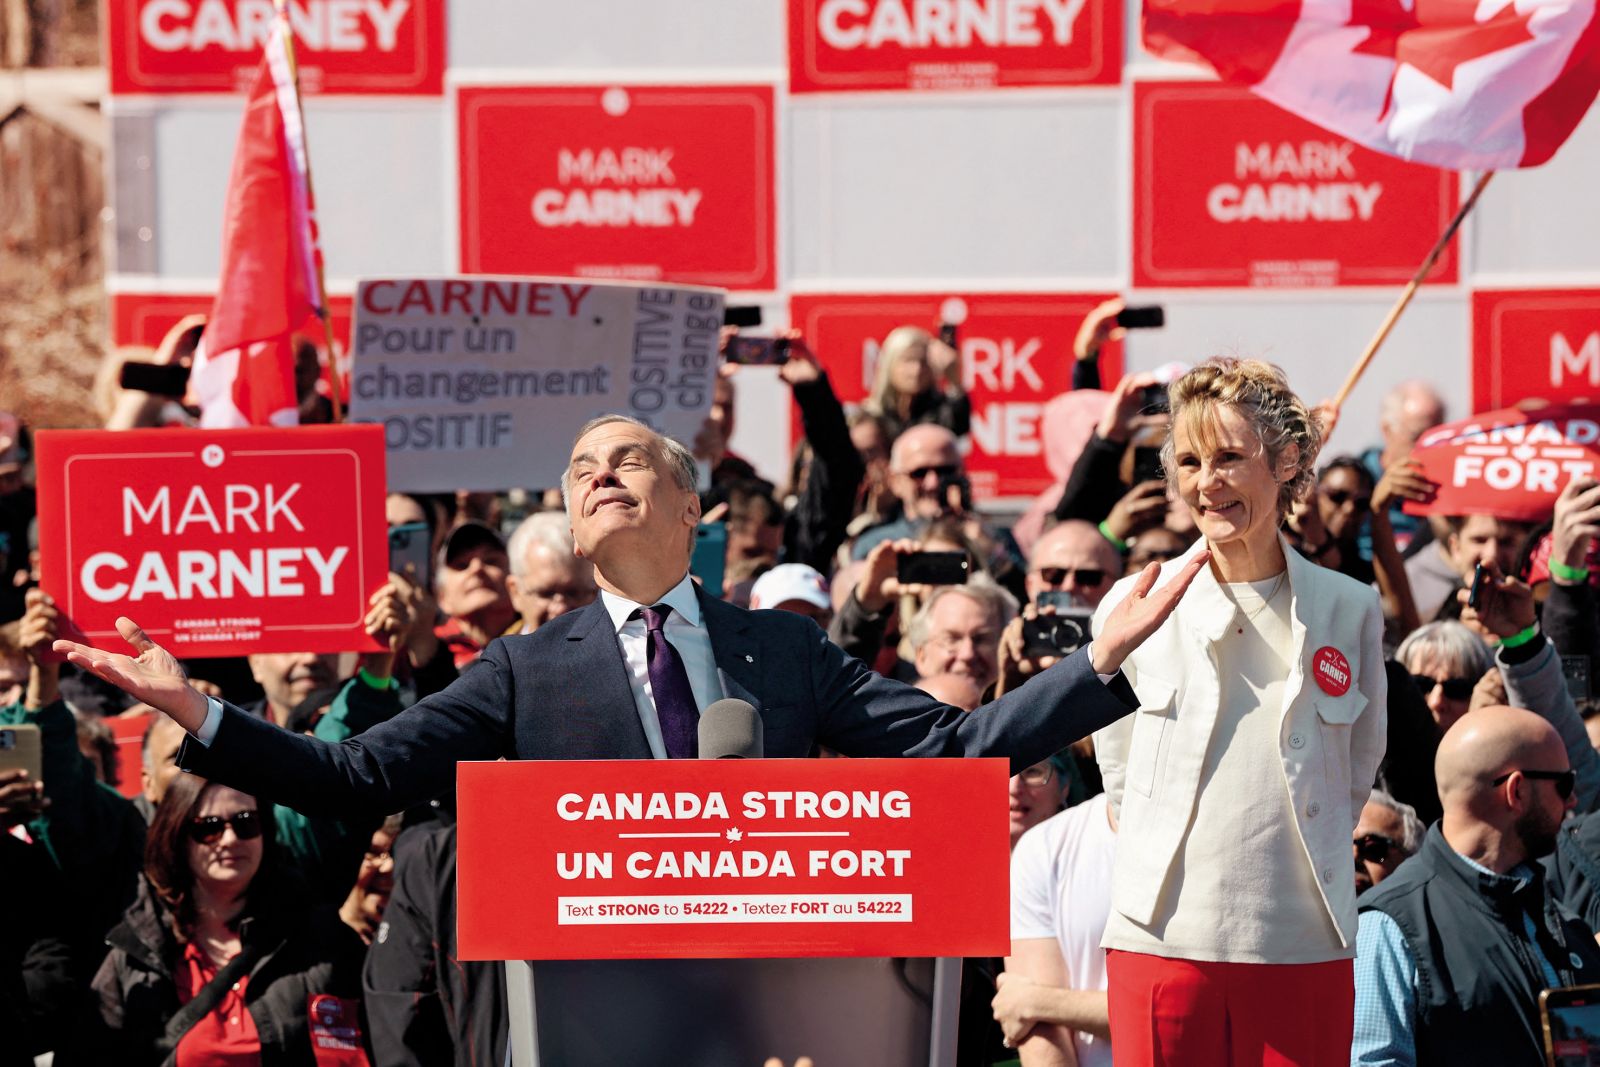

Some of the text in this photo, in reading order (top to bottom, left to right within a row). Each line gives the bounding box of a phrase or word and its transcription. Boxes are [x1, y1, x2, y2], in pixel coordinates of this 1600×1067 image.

[139, 0, 409, 52] CARNEY
[817, 0, 1086, 49] CARNEY
[558, 147, 676, 185] MARK
[1235, 140, 1356, 180] MARK
[531, 187, 702, 228] CARNEY
[1206, 181, 1383, 223] CARNEY
[362, 279, 594, 317] CARNEY
[358, 323, 516, 354] Pour un
[630, 289, 674, 424] OSITIVE
[668, 294, 719, 408] change
[355, 364, 610, 404] changement
[357, 411, 513, 450] OSITIF
[1453, 456, 1594, 493] FORT
[122, 483, 304, 536] MARK
[80, 546, 349, 603] CARNEY
[174, 617, 261, 628] CANADA STRONG
[174, 631, 261, 642] UN CANADA FORT
[1319, 659, 1348, 686] CARNEY
[556, 790, 911, 821] CANADA STRONG
[556, 850, 911, 880] UN CANADA FORT
[566, 902, 902, 917] Text STRONG to 54222 Textez FORT au 54222
